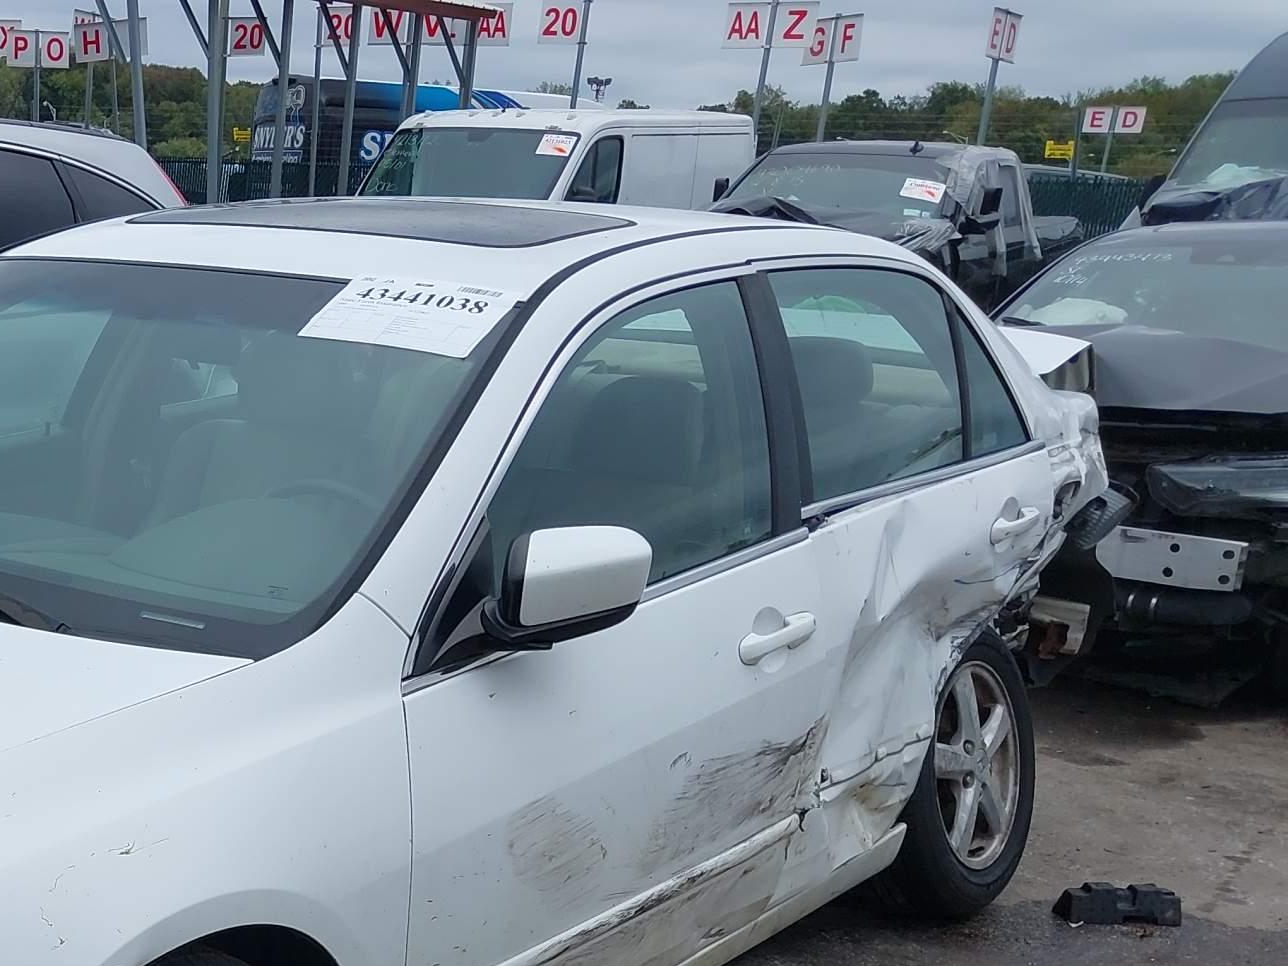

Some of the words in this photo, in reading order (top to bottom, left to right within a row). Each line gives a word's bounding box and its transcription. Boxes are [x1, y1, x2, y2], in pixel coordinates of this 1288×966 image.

[374, 9, 404, 38] W
[477, 11, 506, 38] AA
[542, 7, 578, 36] 20
[727, 10, 760, 40] AA
[783, 10, 808, 39] Z
[990, 17, 1002, 49] E
[14, 36, 28, 59] P
[46, 37, 63, 61] O
[82, 29, 101, 55] H
[233, 23, 264, 49] 20
[810, 27, 825, 57] G
[840, 23, 856, 53] F
[1005, 22, 1016, 53] D
[1089, 111, 1106, 128] E
[1121, 111, 1138, 128] D
[355, 287, 489, 314] 43441038
